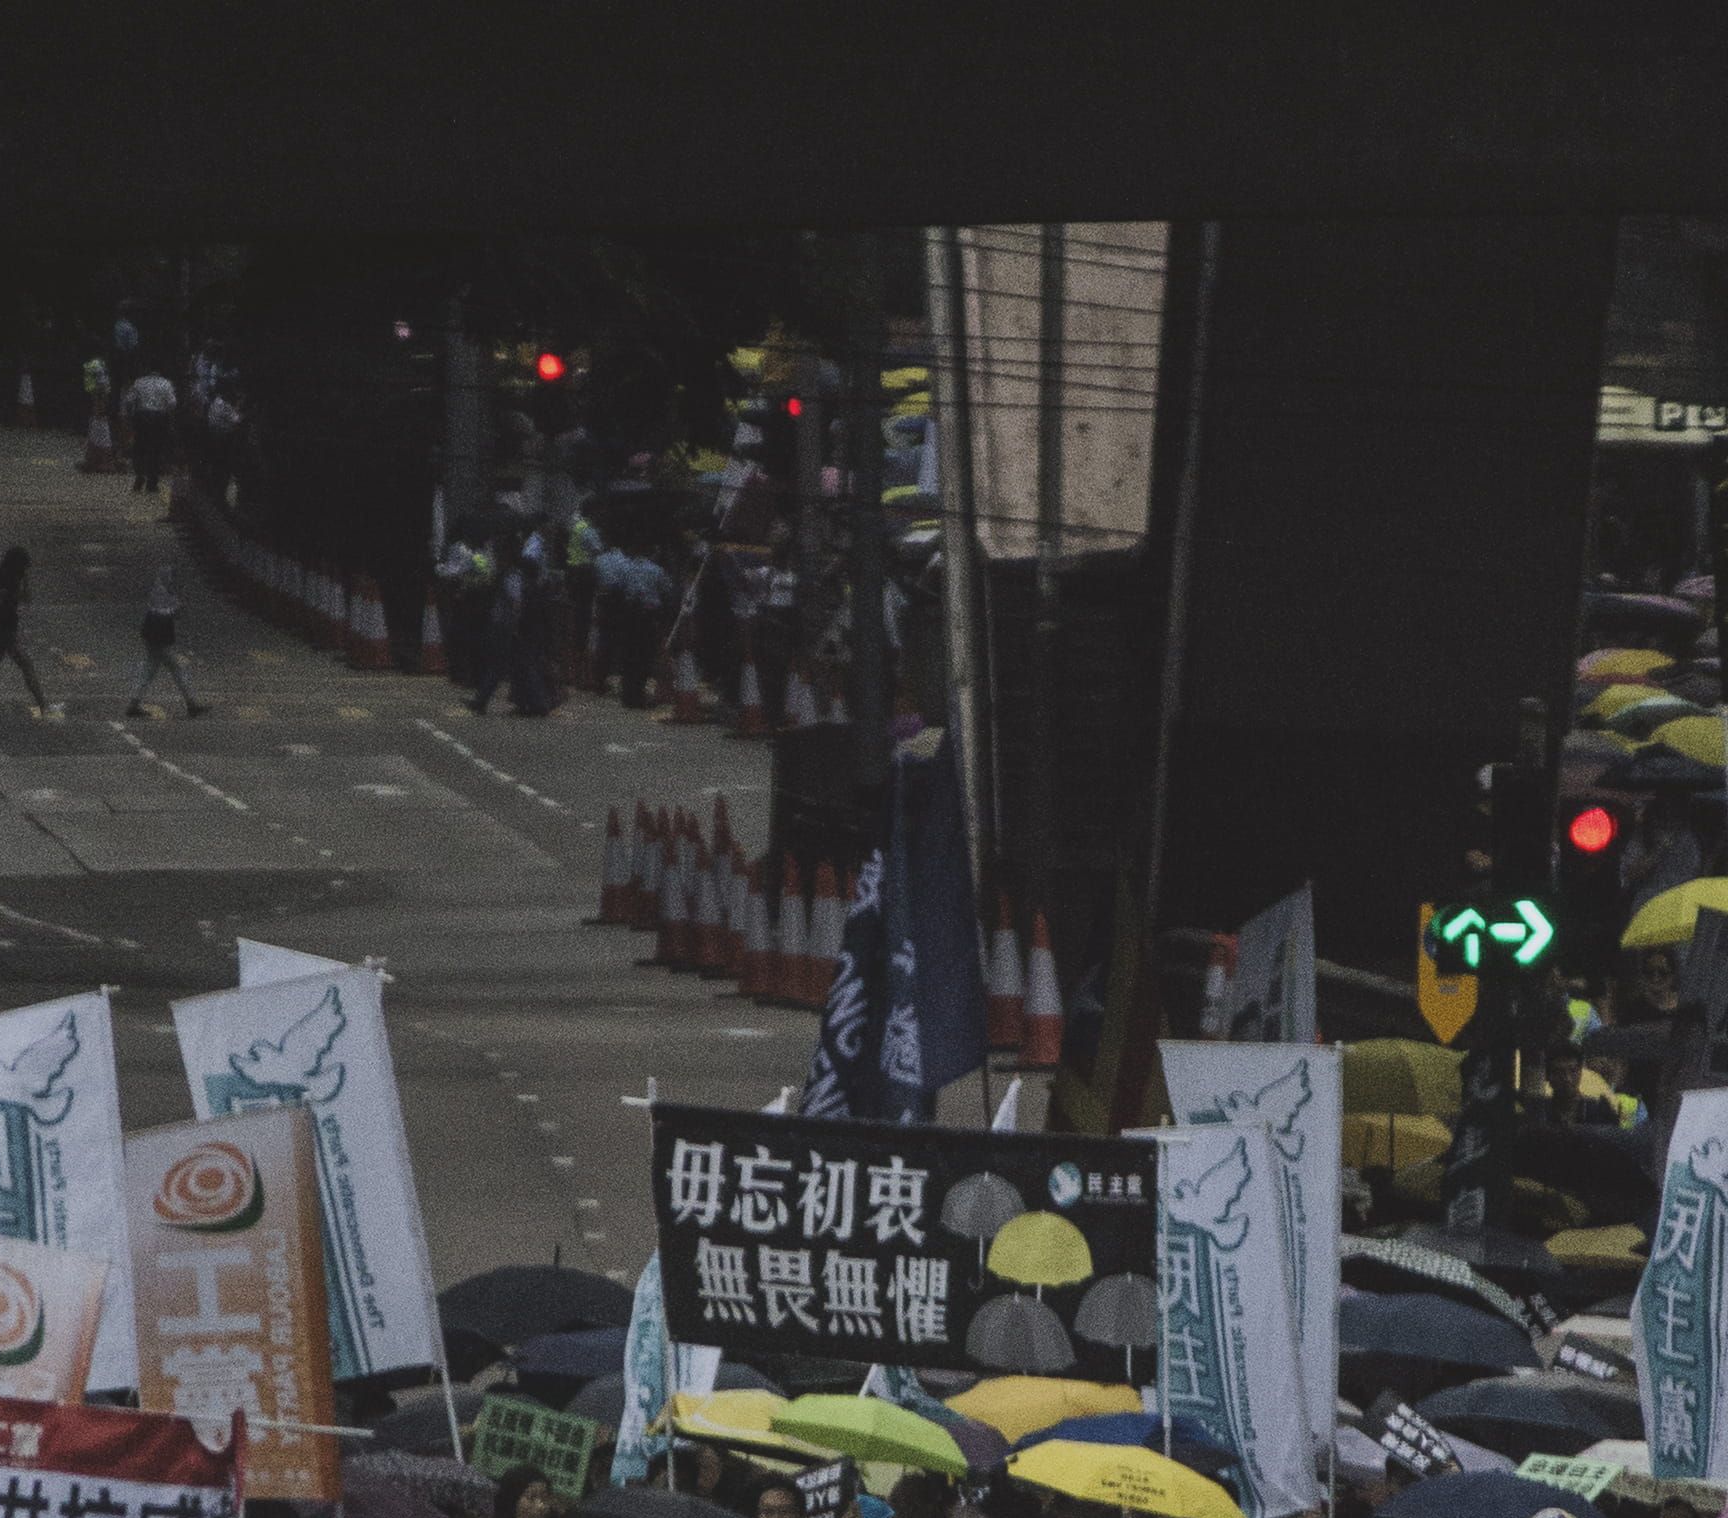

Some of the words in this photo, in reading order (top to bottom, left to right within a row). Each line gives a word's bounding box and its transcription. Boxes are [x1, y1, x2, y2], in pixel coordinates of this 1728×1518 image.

[665, 1137, 930, 1246] 毋忘初衷
[694, 1236, 952, 1346] 無畏無懼
